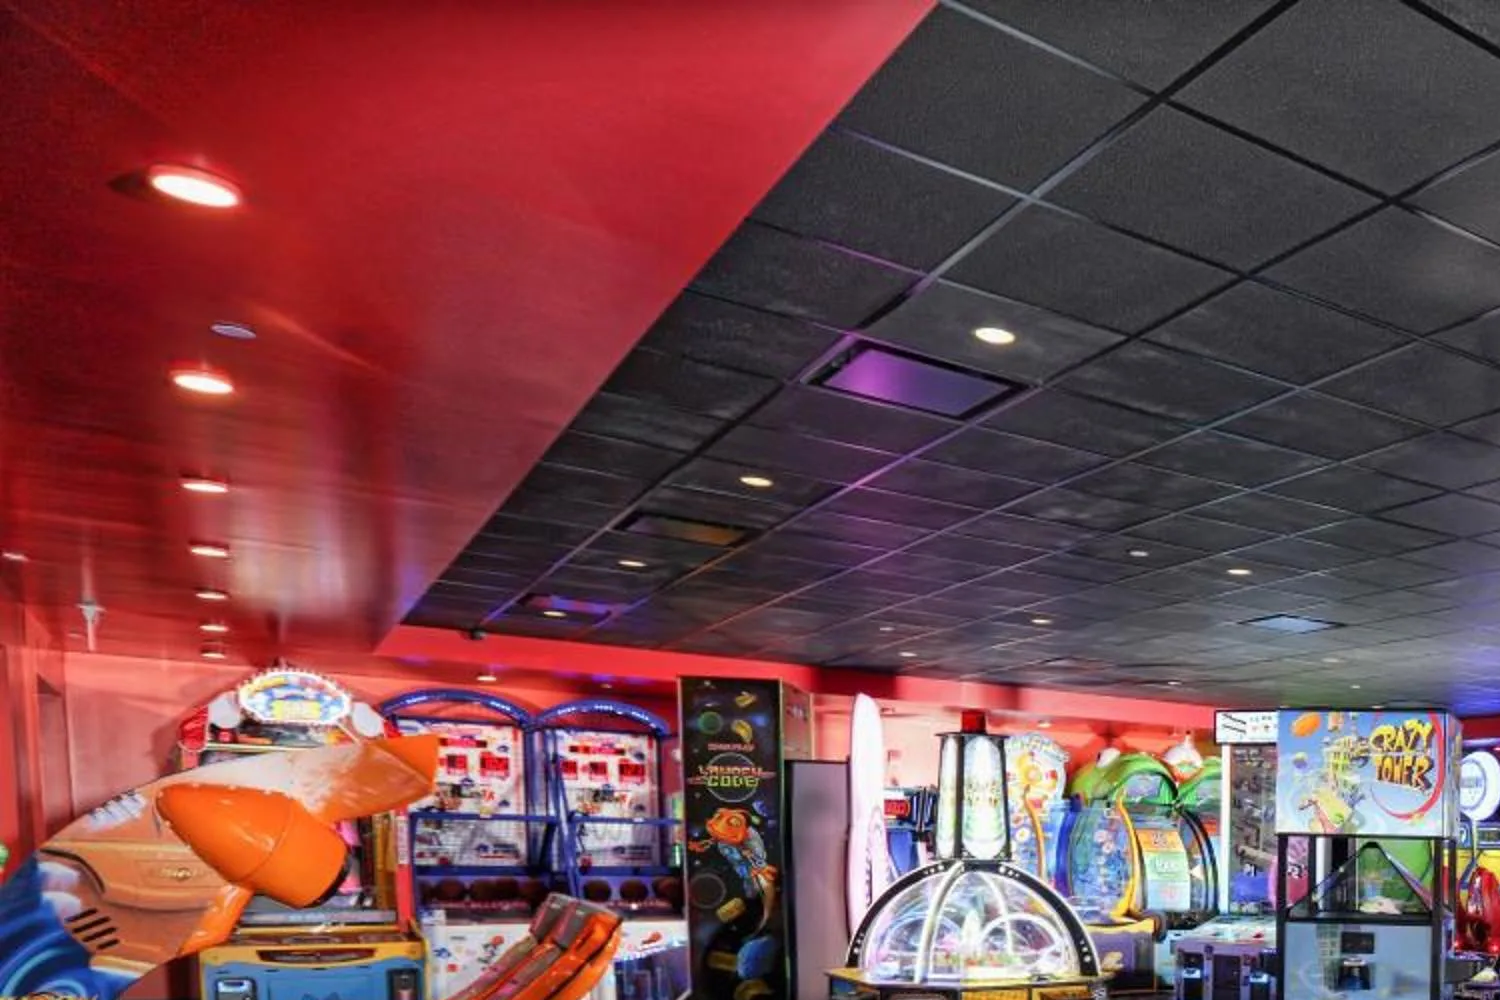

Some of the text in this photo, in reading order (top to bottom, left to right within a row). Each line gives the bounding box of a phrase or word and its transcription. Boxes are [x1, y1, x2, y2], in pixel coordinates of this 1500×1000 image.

[1369, 718, 1433, 753] CRAZY
[706, 775, 760, 788] CODE
[1374, 754, 1432, 790] TOWER
